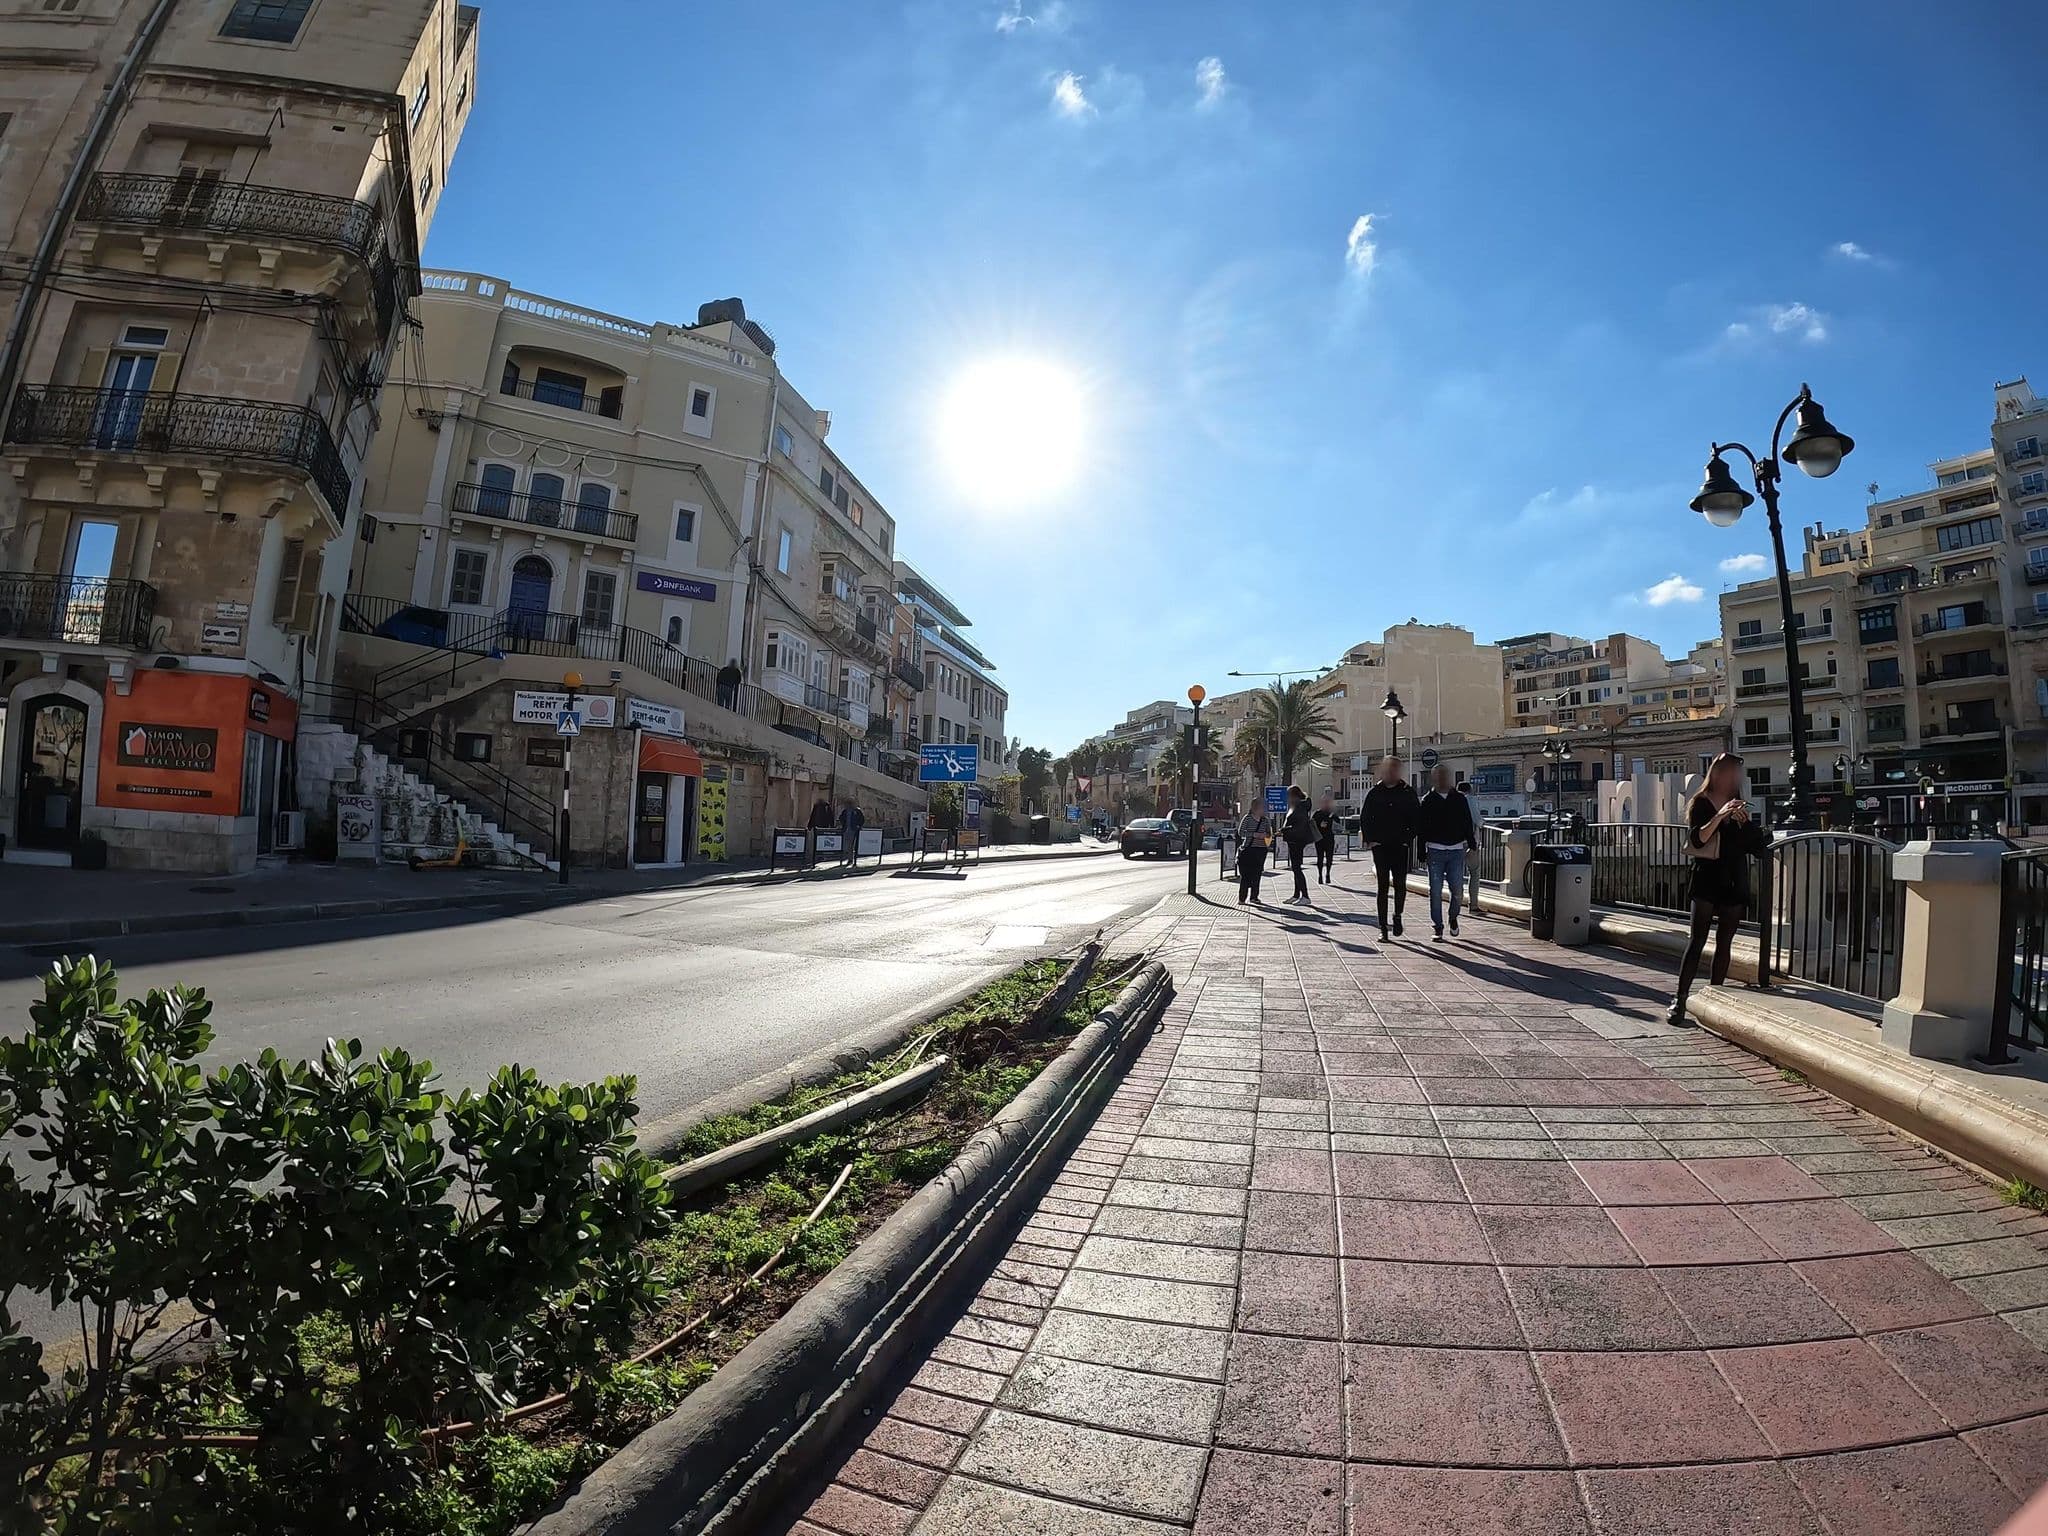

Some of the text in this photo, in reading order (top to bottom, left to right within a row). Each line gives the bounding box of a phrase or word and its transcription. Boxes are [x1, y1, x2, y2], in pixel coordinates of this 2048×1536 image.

[533, 700, 558, 709] RENT
[519, 710, 553, 720] MOTOR
[147, 730, 183, 740] SIMON
[145, 740, 211, 760] MAMO
[144, 757, 211, 769] REAL ESTAT
[1946, 783, 1992, 793] McDonald's
